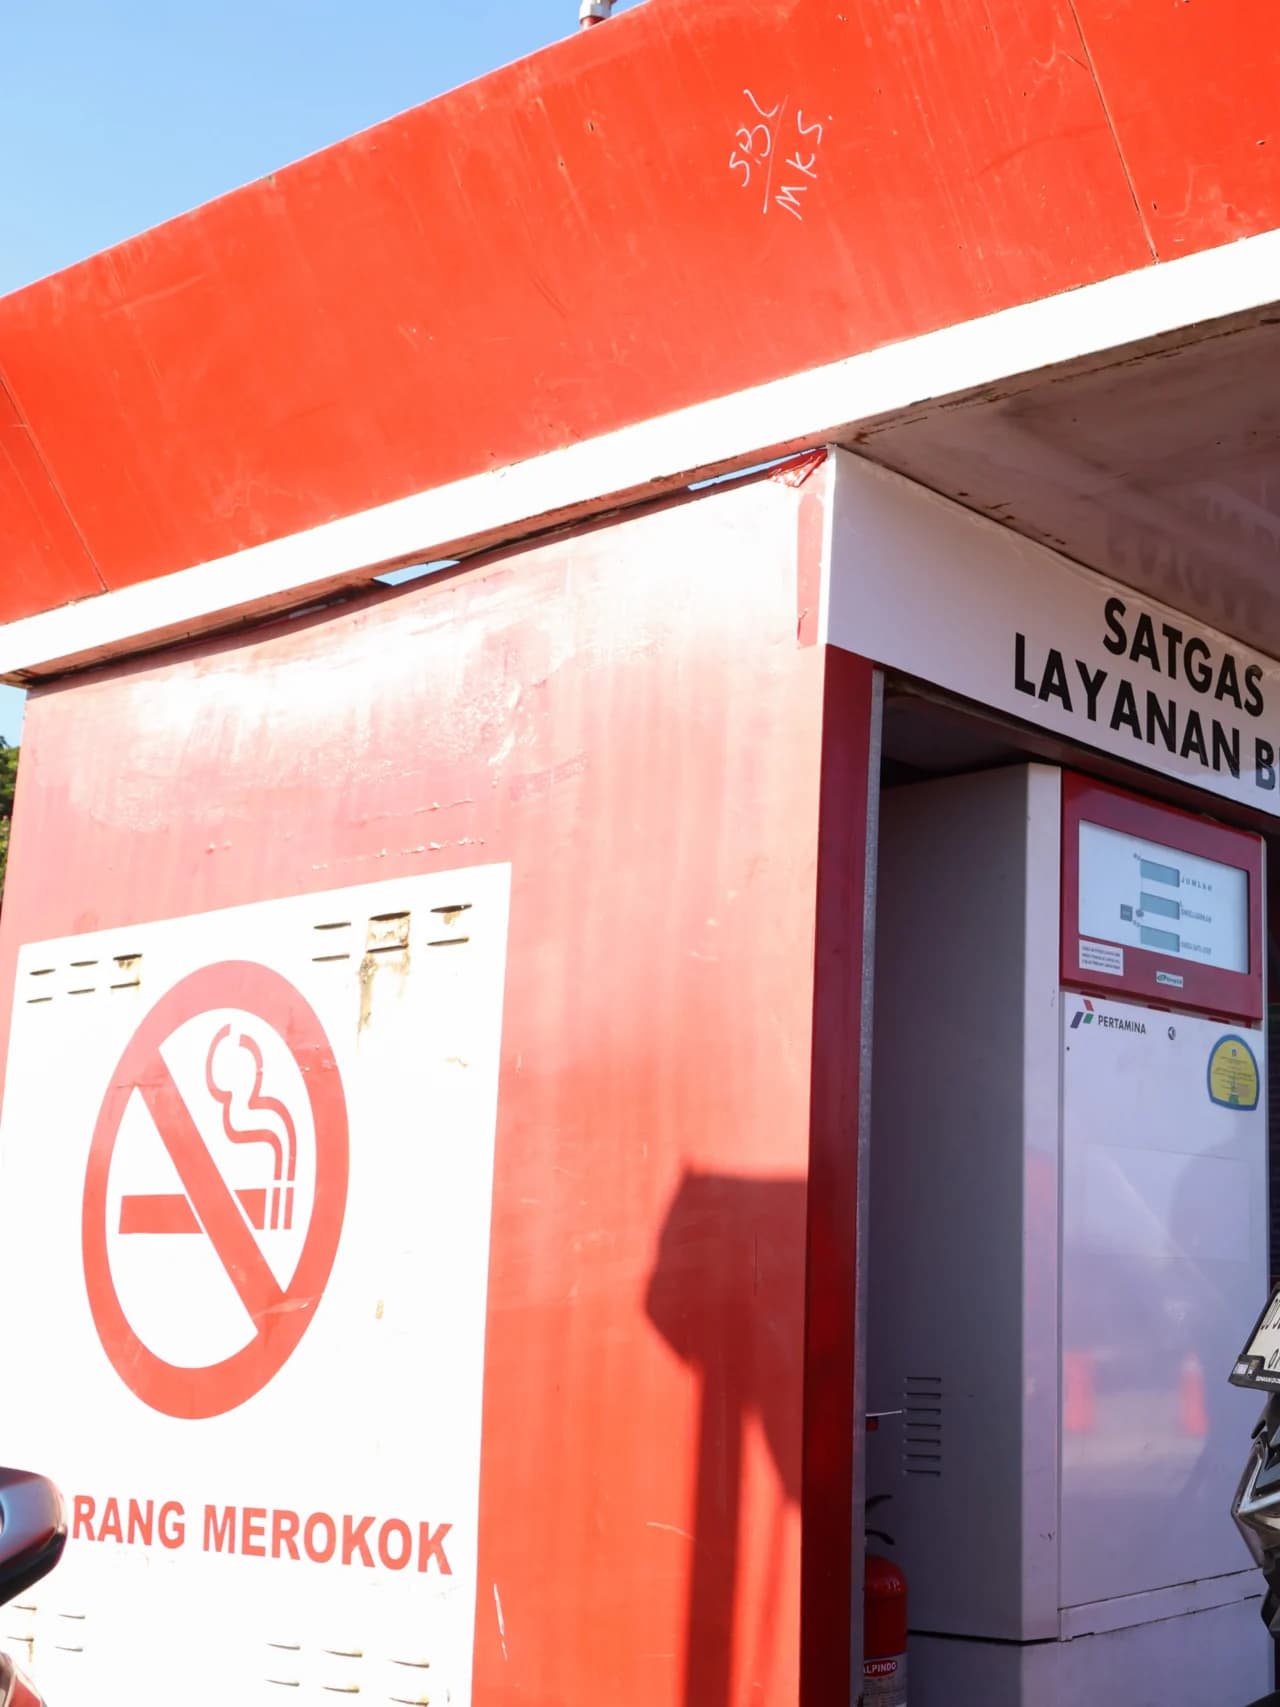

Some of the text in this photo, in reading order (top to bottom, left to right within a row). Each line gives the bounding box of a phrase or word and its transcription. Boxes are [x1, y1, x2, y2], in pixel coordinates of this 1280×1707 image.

[1103, 597, 1264, 718] SATGAS
[1014, 632, 1240, 780] LAYANAN
[1097, 1014, 1147, 1035] PERTAMINA
[203, 1504, 454, 1576] MEROKOK
